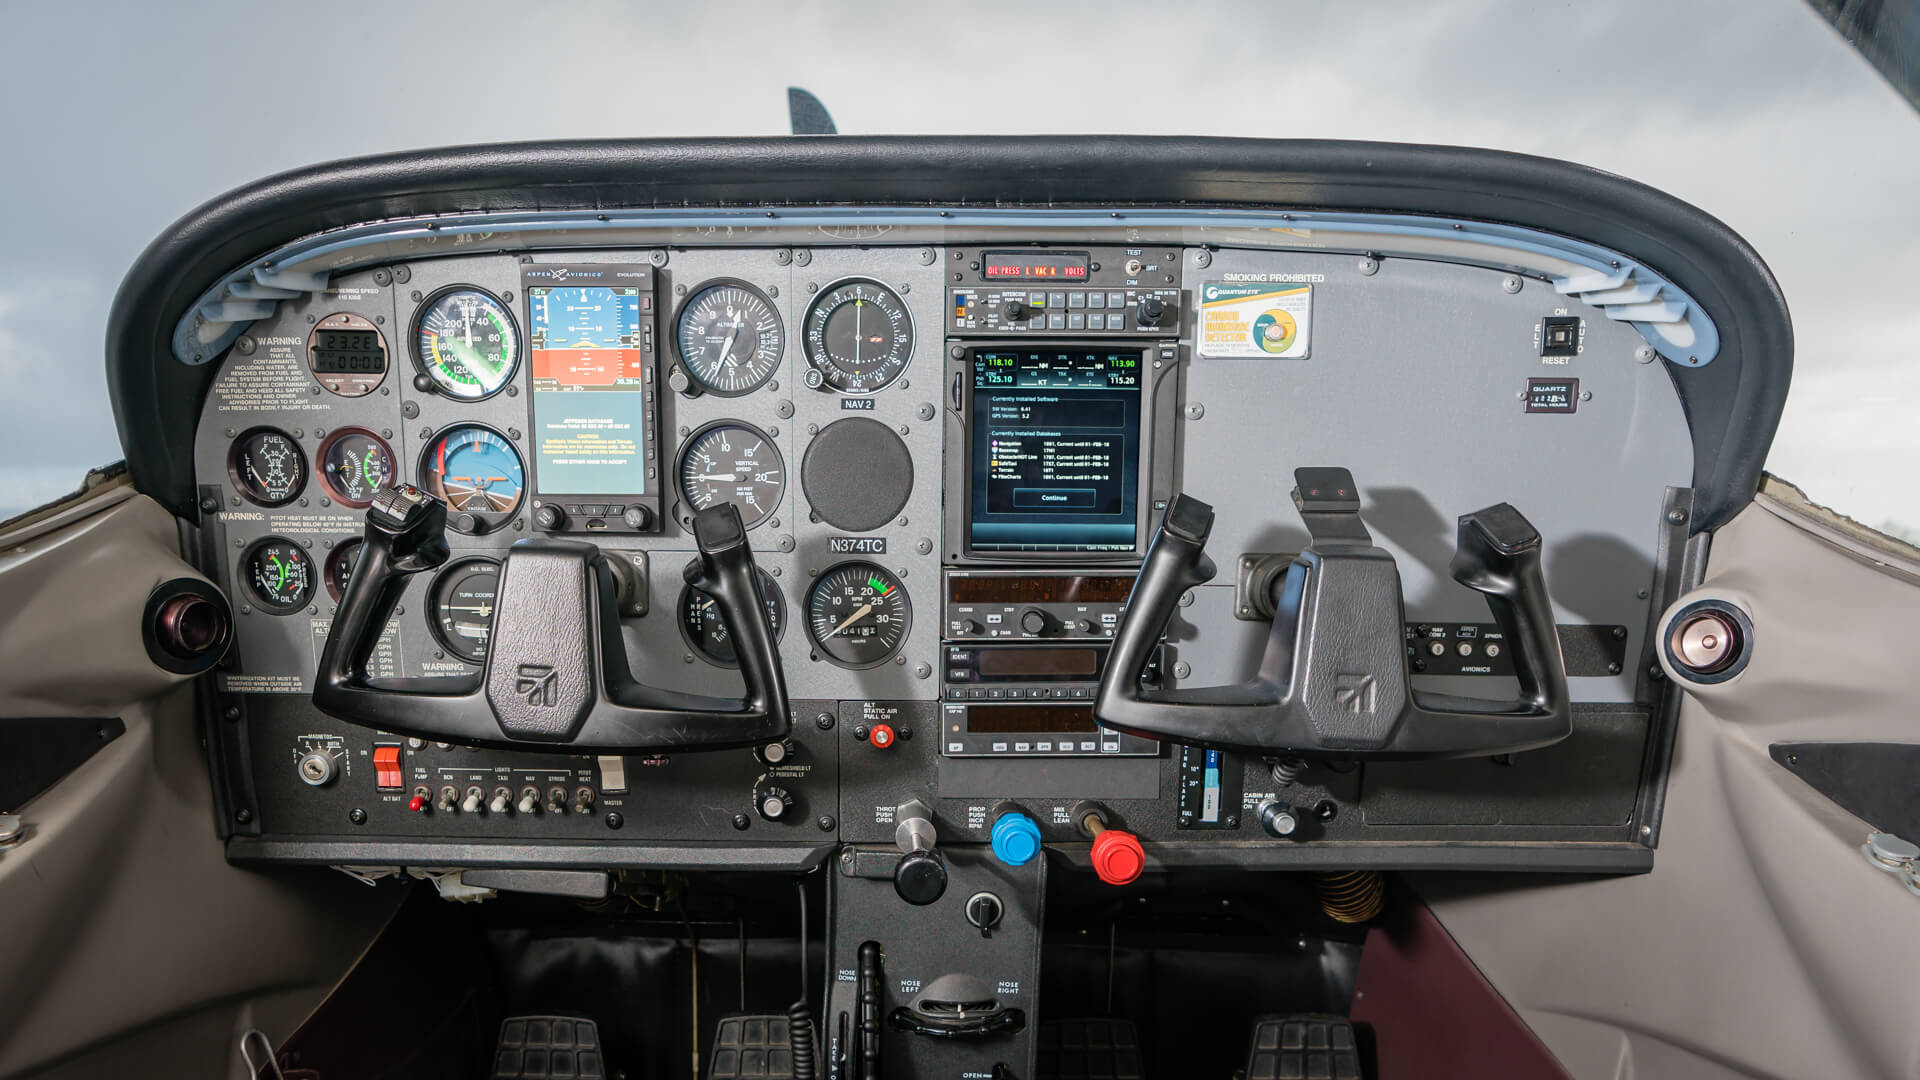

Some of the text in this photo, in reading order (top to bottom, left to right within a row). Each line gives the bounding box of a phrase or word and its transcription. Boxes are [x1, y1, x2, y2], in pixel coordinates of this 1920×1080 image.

[987, 267, 1084, 276] OIL PRESS VAC VOLTS
[878, 292, 886, 301] E
[710, 311, 716, 319] 9
[815, 309, 825, 318] N
[892, 310, 902, 320] 12
[756, 322, 763, 330] 2
[810, 331, 818, 342] 33
[898, 334, 906, 342] 15
[1206, 333, 1246, 342] DETECTOR
[814, 354, 825, 364] 30
[892, 358, 900, 366] S
[876, 374, 884, 382] 21
[845, 400, 864, 408] NAV
[744, 448, 754, 457] 15
[755, 474, 768, 482] 20
[746, 496, 755, 504] 15
[832, 540, 883, 552] N374TC
[845, 587, 854, 596] 15
[860, 588, 874, 596] 20
[832, 597, 842, 605] 10
[870, 597, 884, 606] 25
